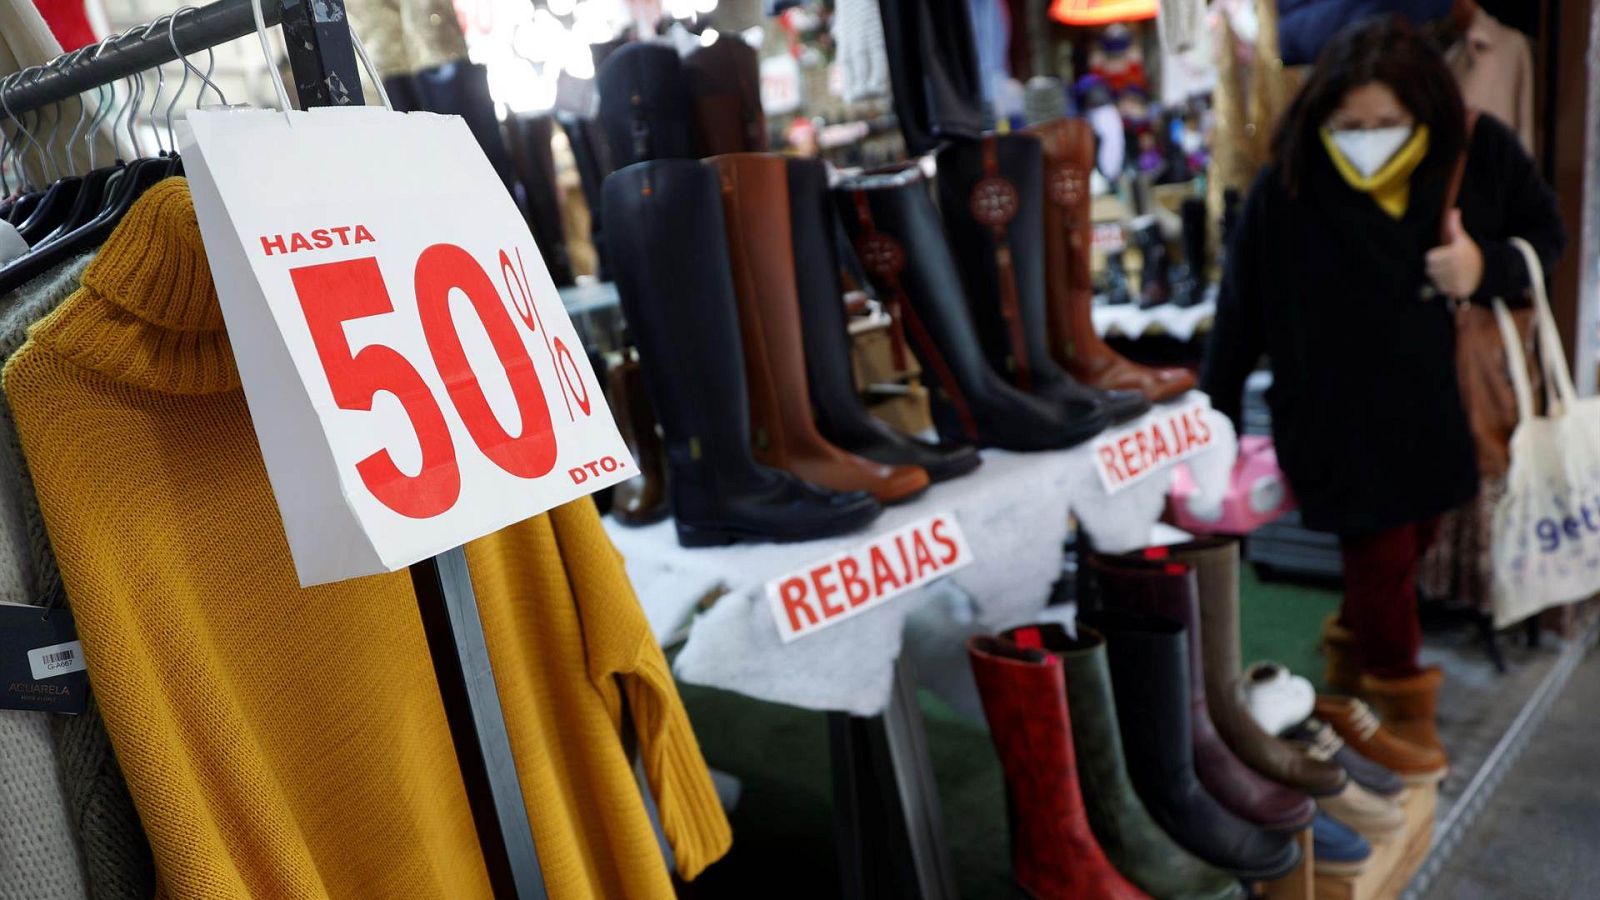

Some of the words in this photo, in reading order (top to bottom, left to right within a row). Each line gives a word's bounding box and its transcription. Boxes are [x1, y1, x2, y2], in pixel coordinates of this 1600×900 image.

[260, 225, 375, 257] HASTA
[568, 455, 626, 486] DTO.
[1098, 407, 1212, 485] REBAJAS
[779, 518, 959, 633] REBAJAS
